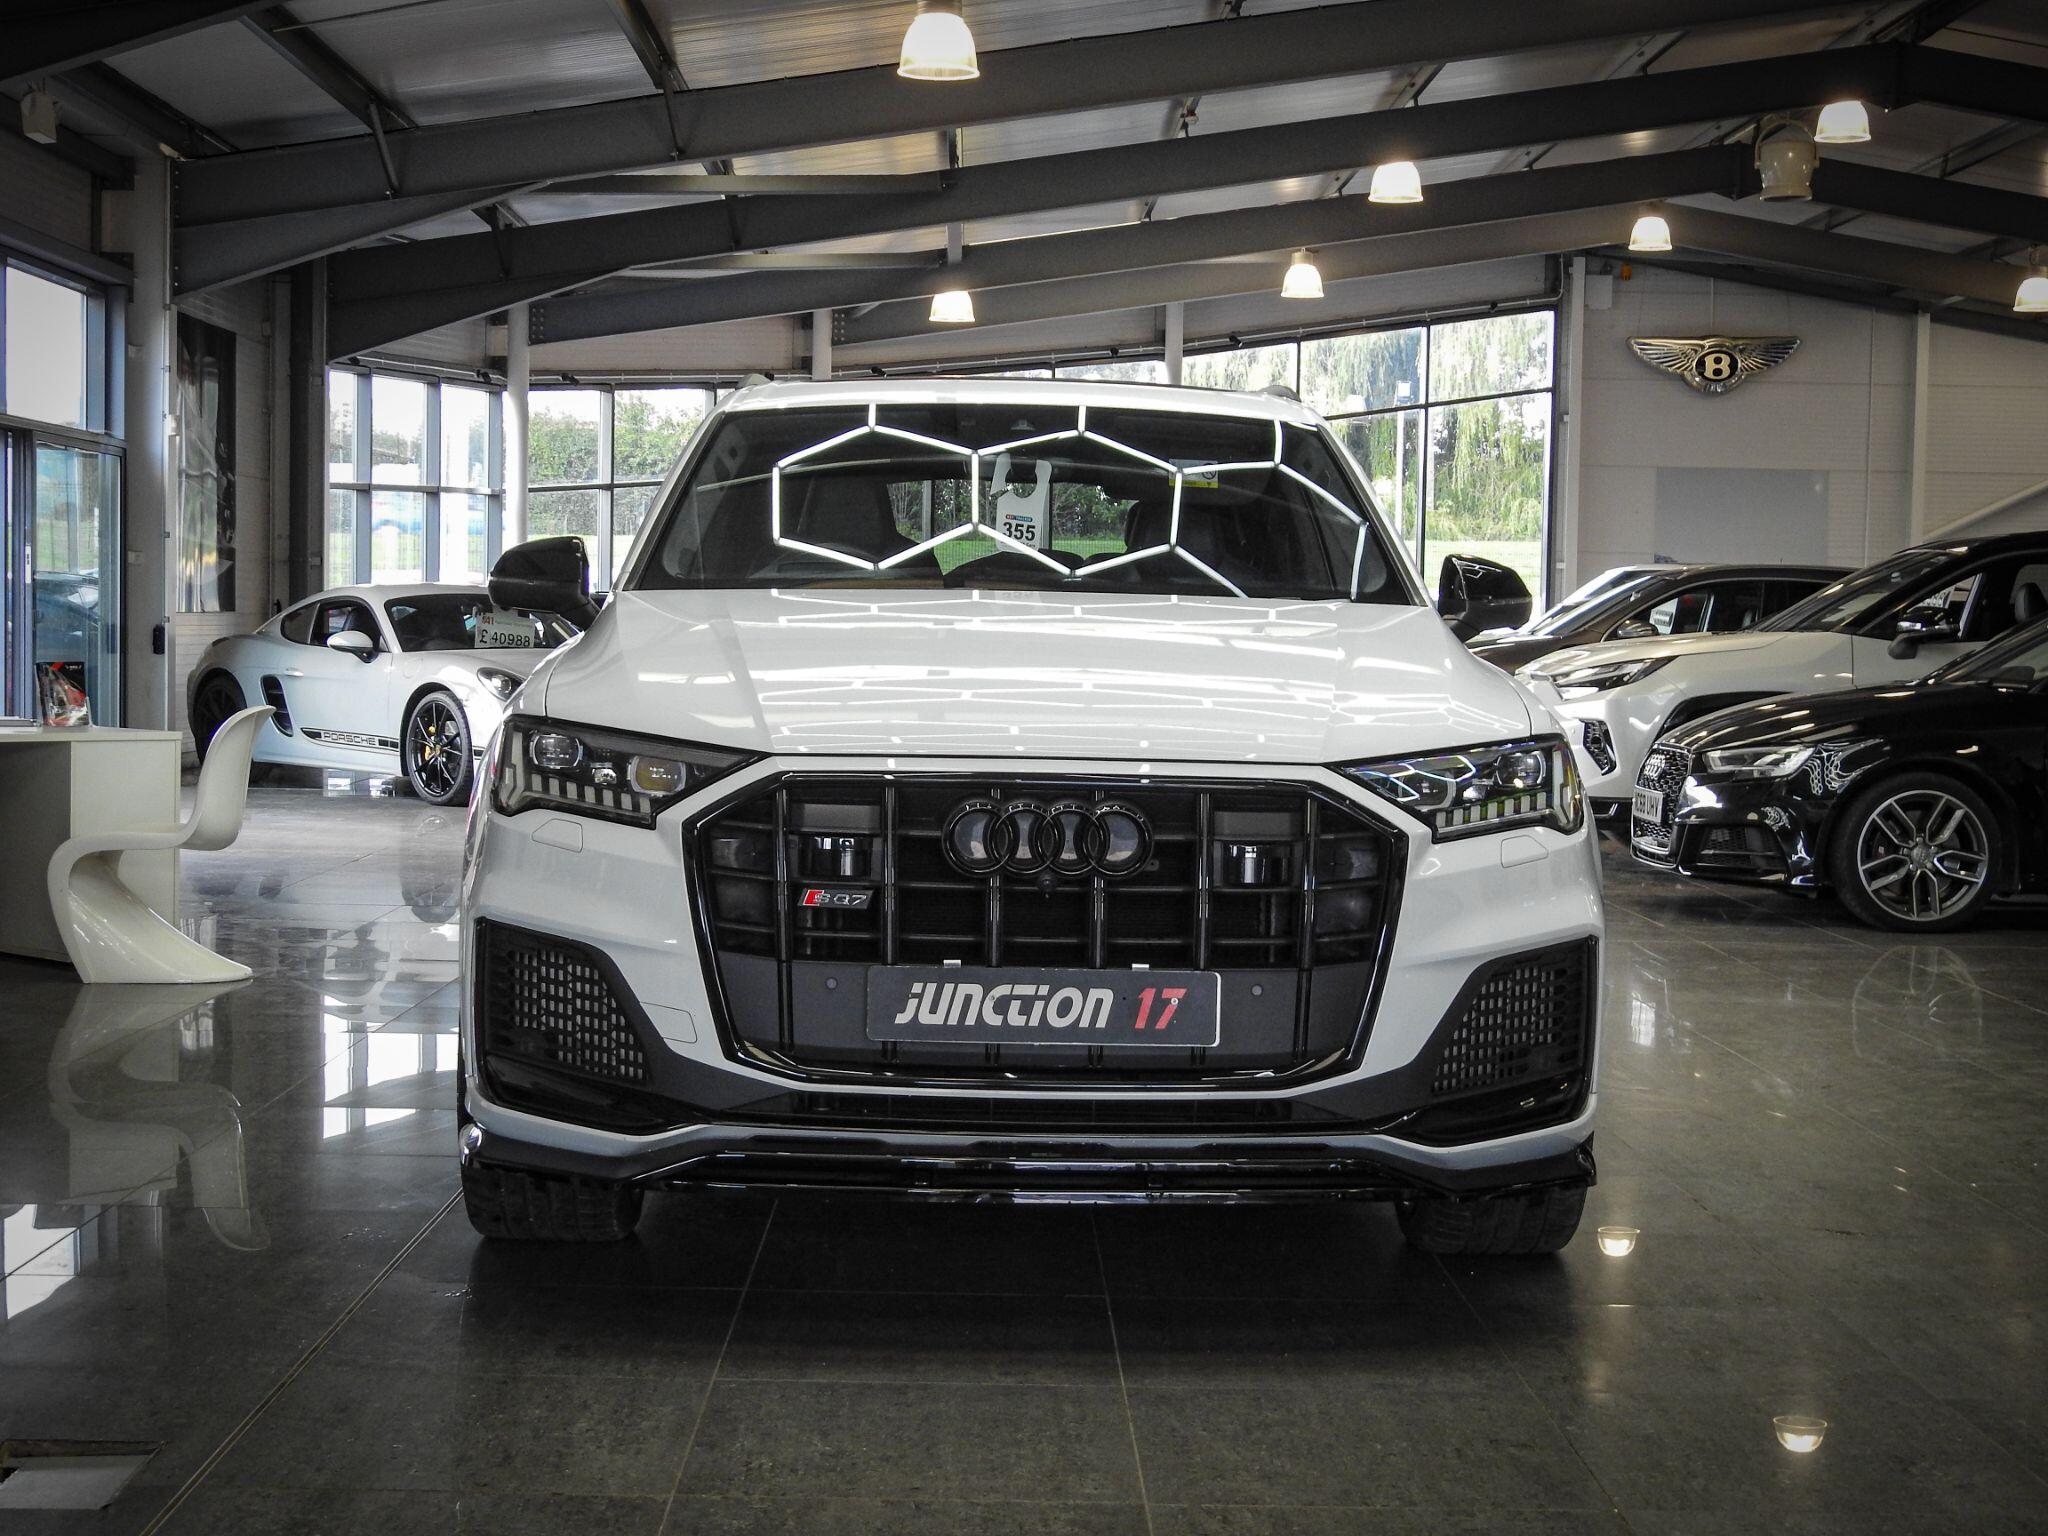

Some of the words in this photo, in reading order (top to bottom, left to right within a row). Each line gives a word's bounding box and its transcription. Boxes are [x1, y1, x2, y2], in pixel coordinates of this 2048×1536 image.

[1704, 353, 1731, 380] B
[1003, 521, 1036, 541] 355
[323, 731, 376, 746] PORSCHE
[814, 893, 867, 906] SQ7
[1134, 988, 1187, 1029] 17
